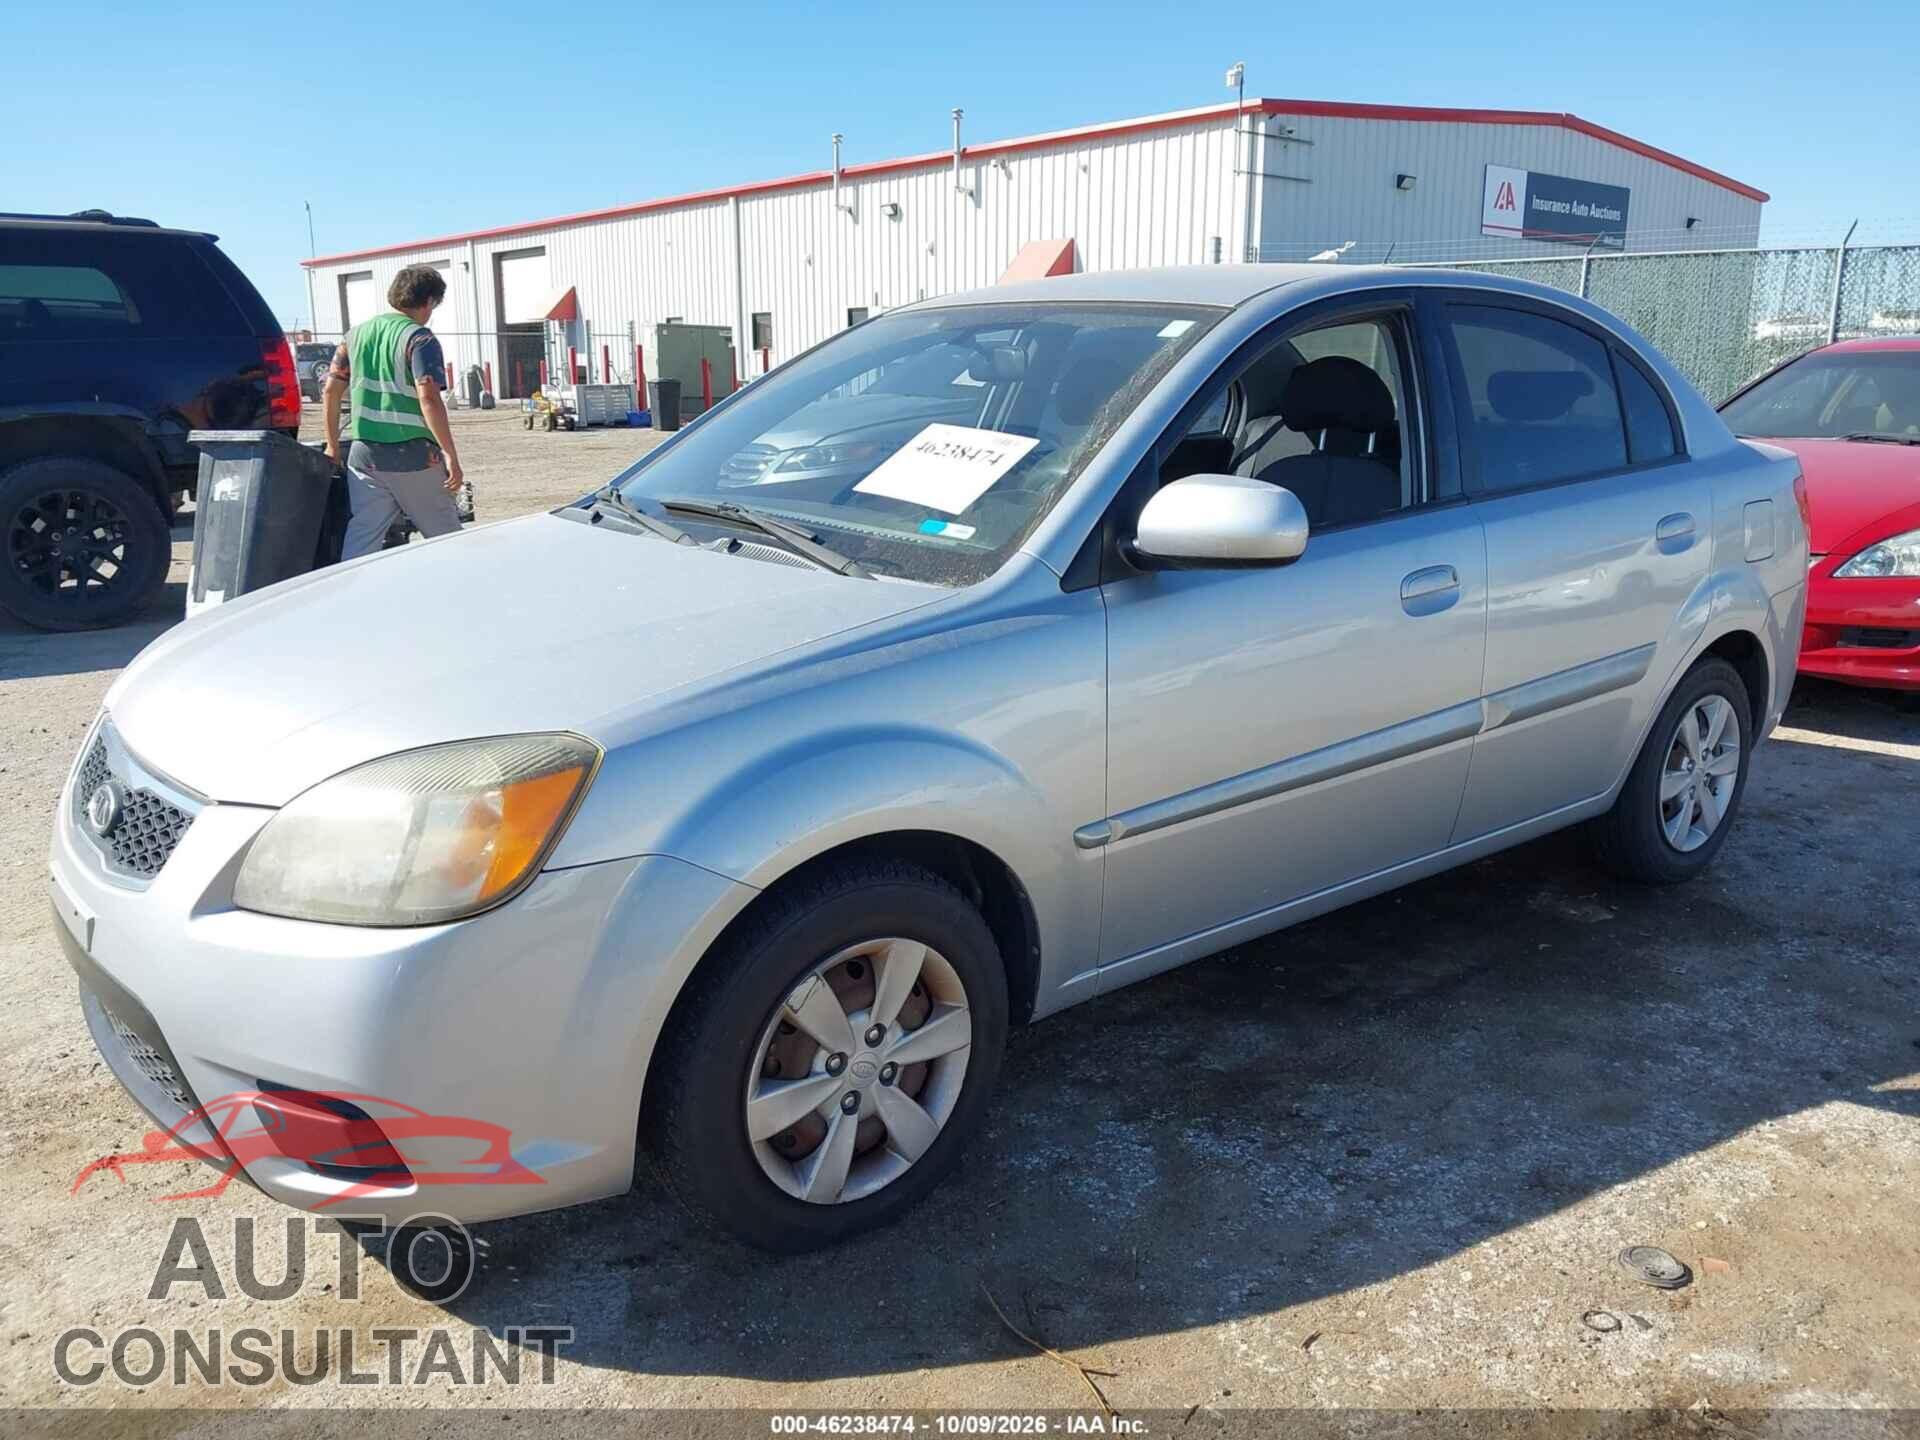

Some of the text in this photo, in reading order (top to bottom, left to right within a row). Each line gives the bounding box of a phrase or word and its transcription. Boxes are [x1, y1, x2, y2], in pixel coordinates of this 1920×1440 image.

[1532, 194, 1622, 221] Insurance Auto Auctions
